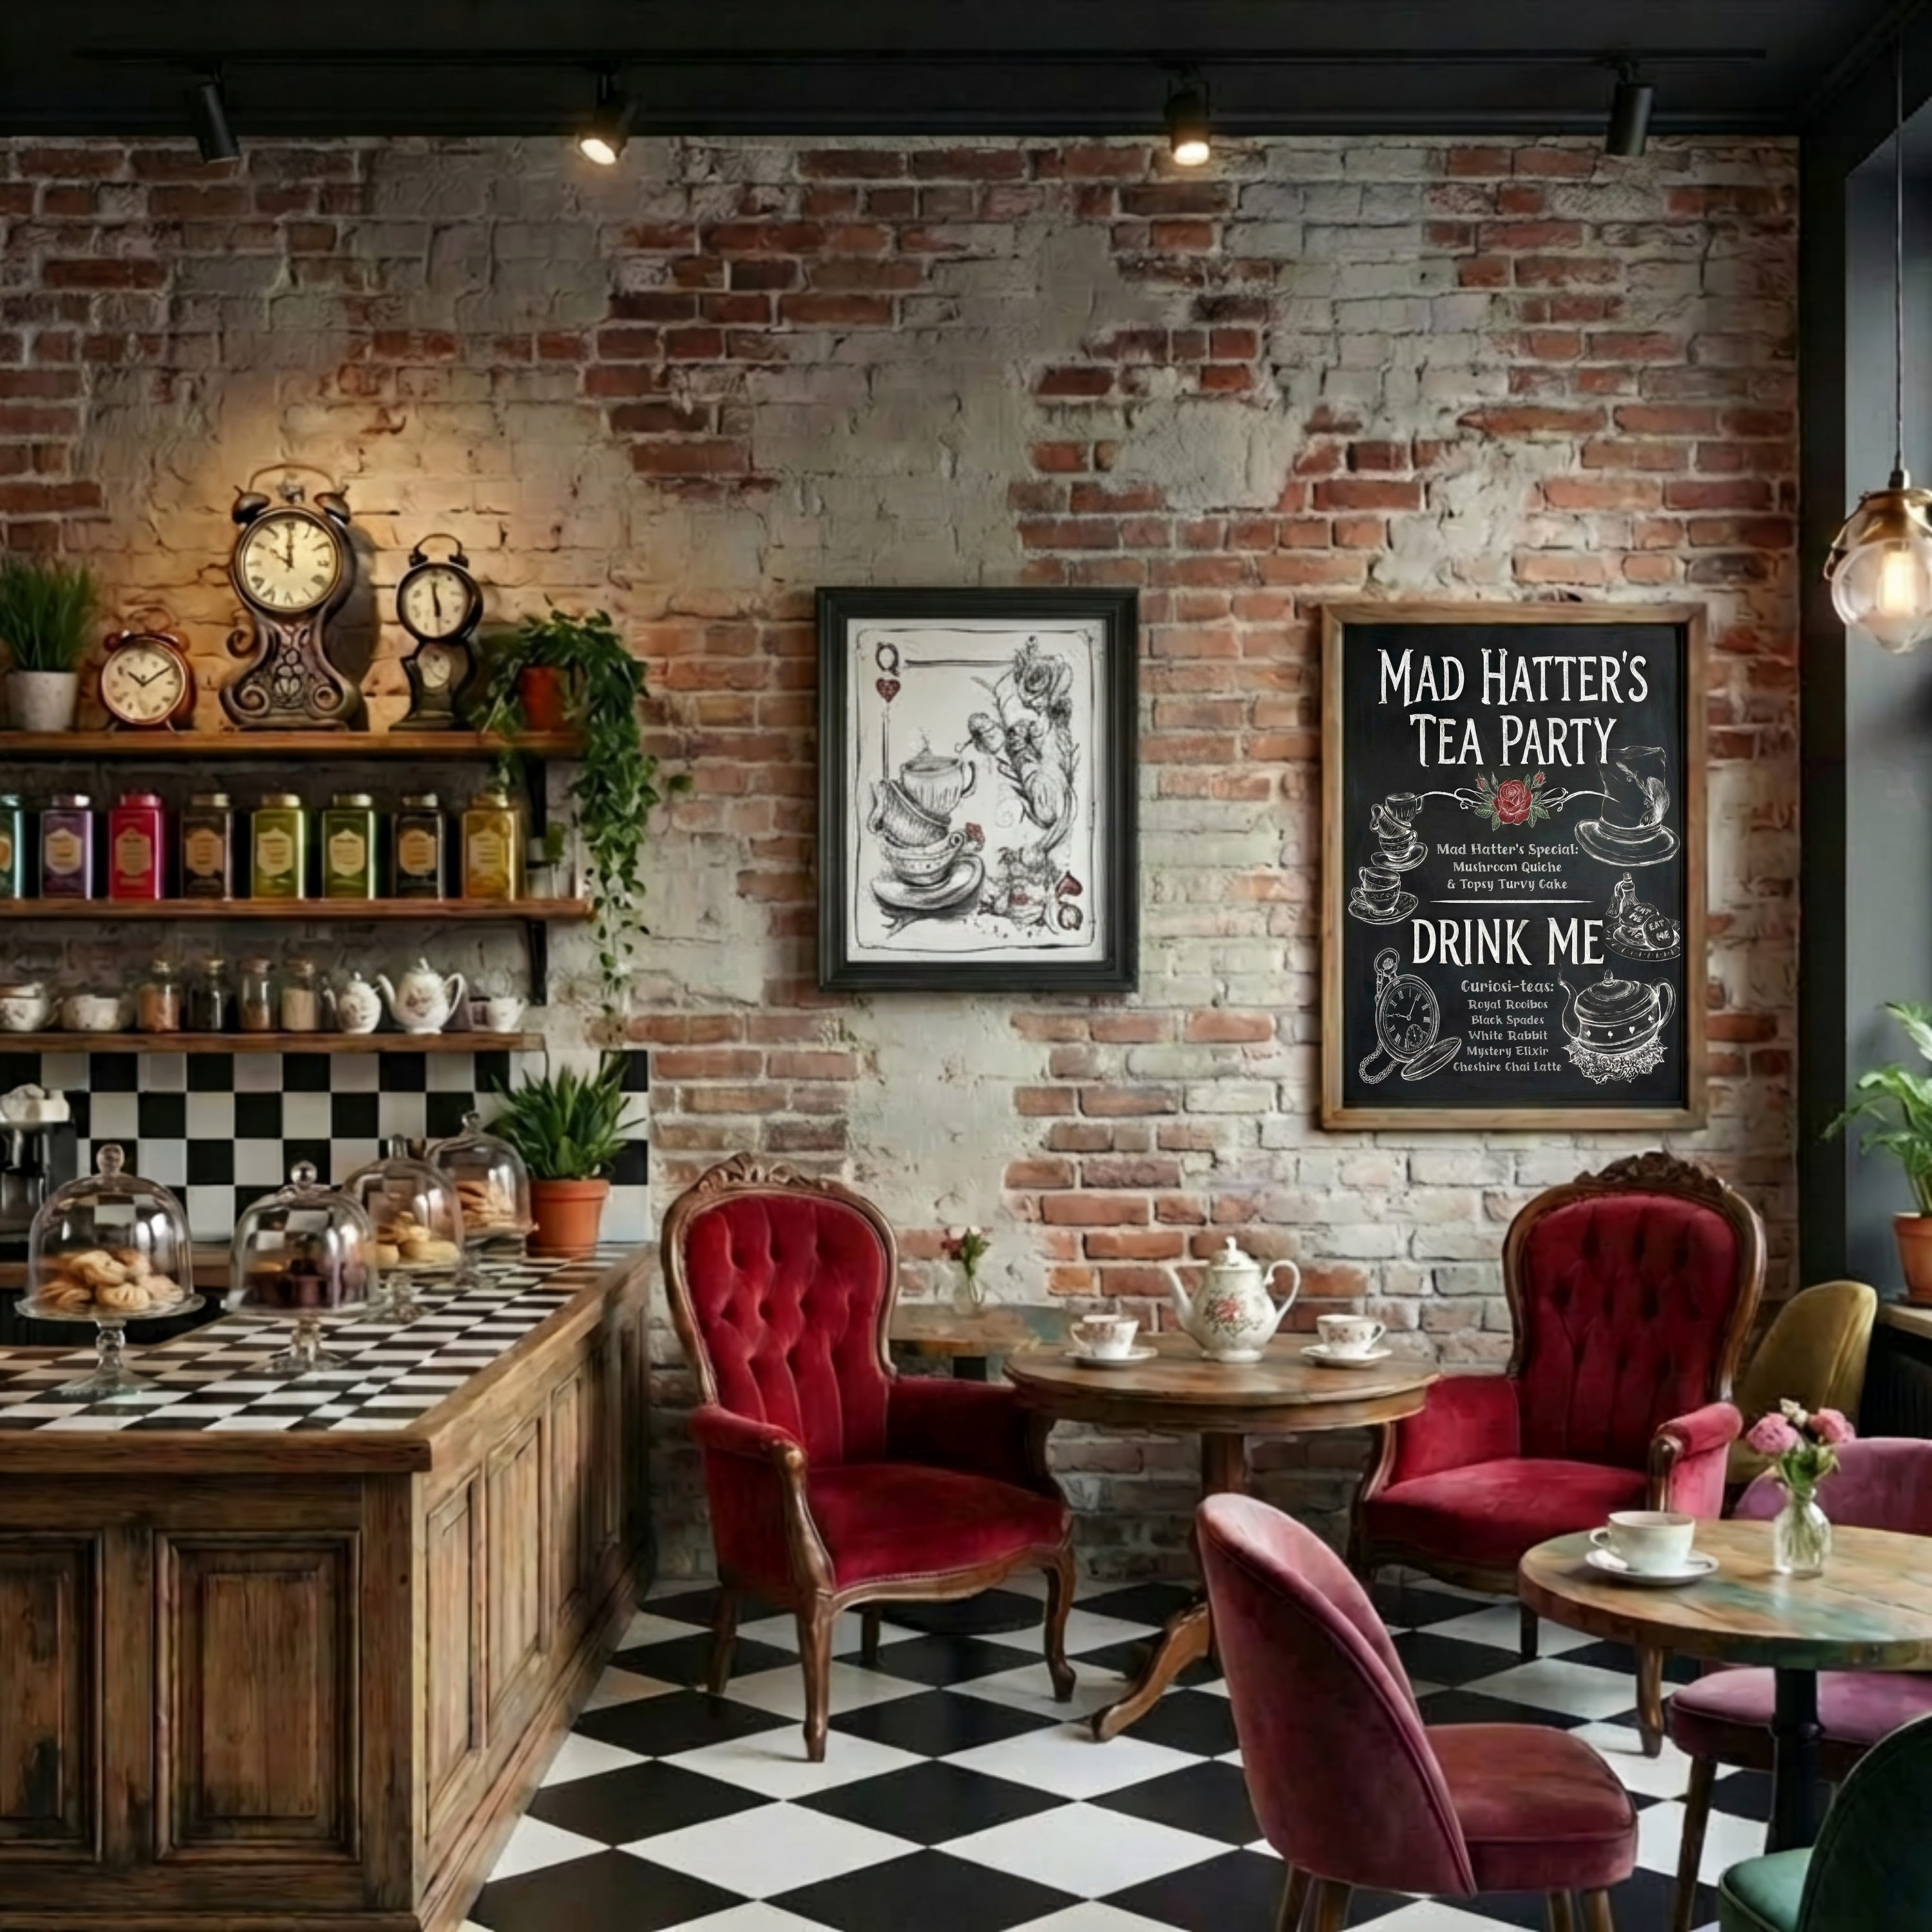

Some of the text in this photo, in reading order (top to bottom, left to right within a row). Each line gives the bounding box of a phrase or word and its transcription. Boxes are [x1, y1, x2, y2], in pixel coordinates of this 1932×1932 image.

[875, 641, 900, 677] Q
[1378, 648, 1649, 708] MAD HATTER'S
[1410, 714, 1617, 768] TEA PARTY
[1437, 843, 1579, 858] Mad Hatter's Special:
[1453, 862, 1563, 874] Mushroom Quiche
[1447, 878, 1569, 892] & Topsy Turvy Cake
[1411, 917, 1604, 967] DRINK ME
[1461, 980, 1555, 993] Curiosi-teas:
[1467, 999, 1548, 1012] Royal Rooibos
[1471, 1015, 1544, 1027] Black Spades
[1468, 1030, 1548, 1041] White Rabbit
[1466, 1046, 1549, 1058] Mystery Elixir
[1453, 1061, 1562, 1072] Cheshire Chai Latte
